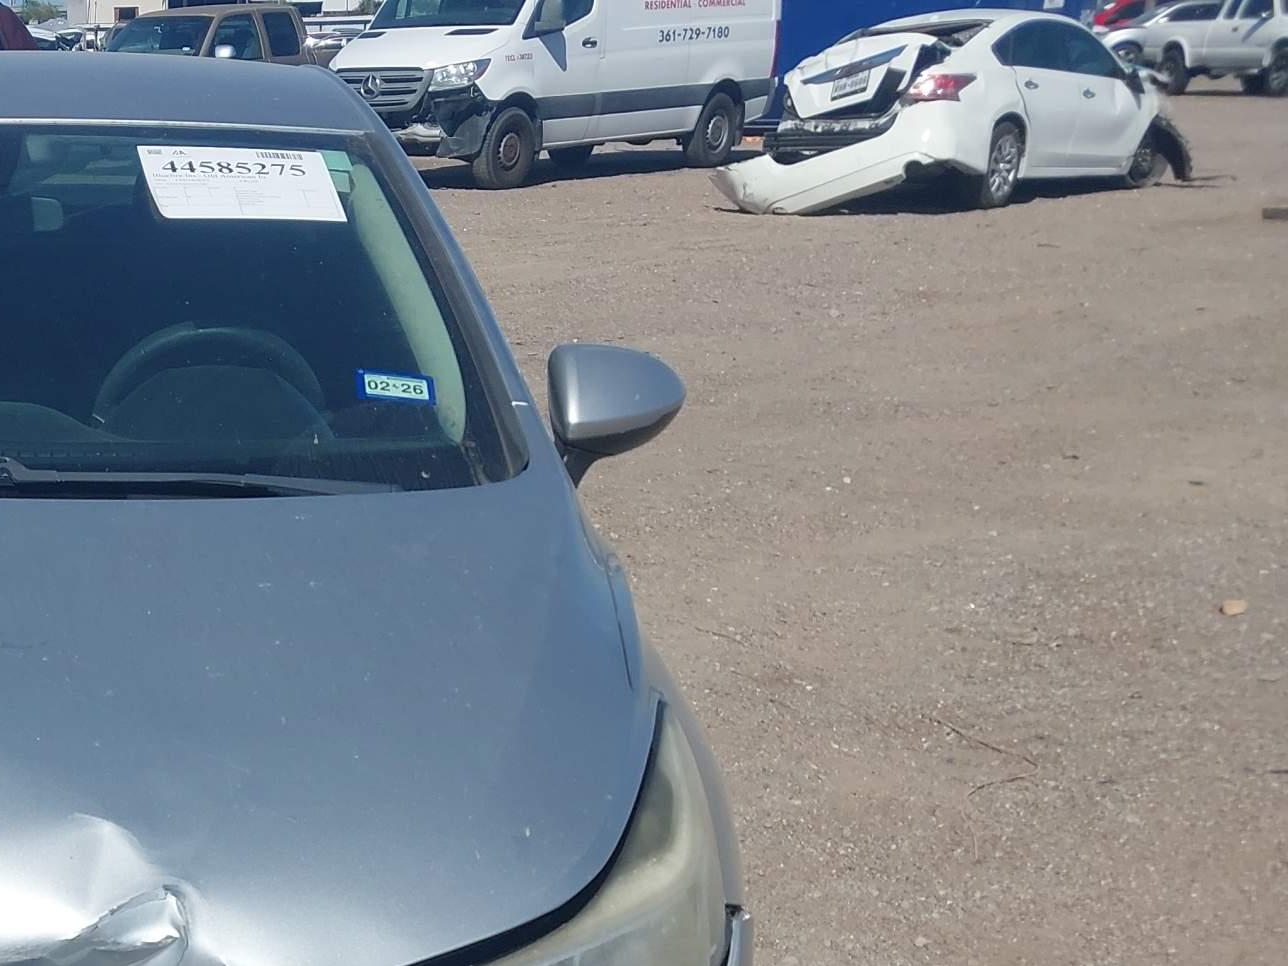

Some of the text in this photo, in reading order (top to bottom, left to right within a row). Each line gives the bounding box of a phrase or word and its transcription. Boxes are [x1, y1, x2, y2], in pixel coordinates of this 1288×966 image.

[644, 0, 692, 10] RESIDENTIAL
[658, 25, 731, 43] 361-729-7180
[160, 159, 308, 177] 44585275
